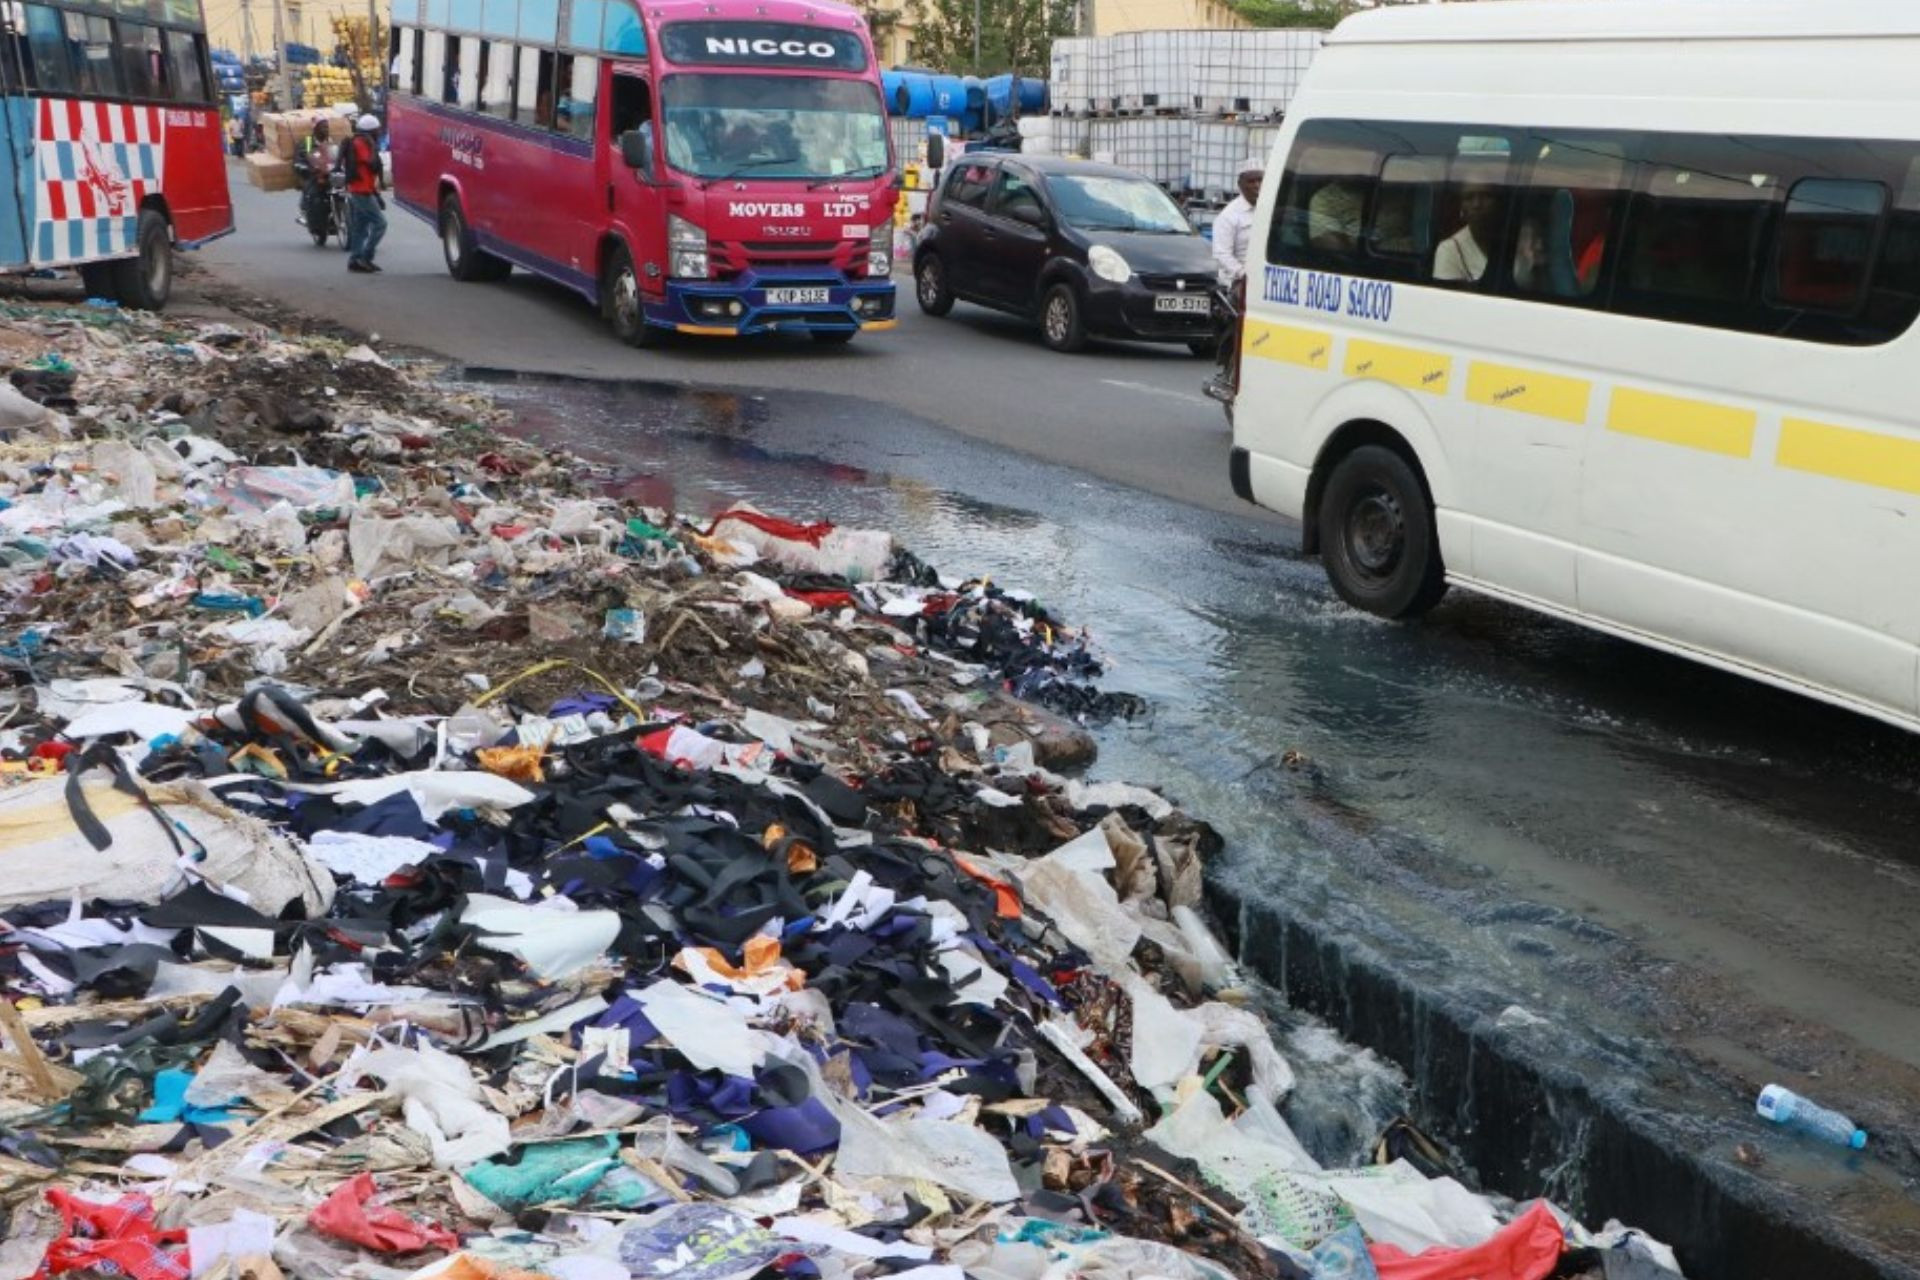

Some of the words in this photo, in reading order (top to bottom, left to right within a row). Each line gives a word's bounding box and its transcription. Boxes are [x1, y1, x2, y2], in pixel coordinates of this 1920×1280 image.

[705, 37, 836, 58] NICCO
[729, 201, 805, 217] MOVERS
[823, 203, 856, 217] LTD
[762, 225, 811, 236] ISUZU
[1264, 265, 1300, 306] THIKA
[1305, 272, 1342, 312] ROAD
[1347, 278, 1393, 322] SACCO
